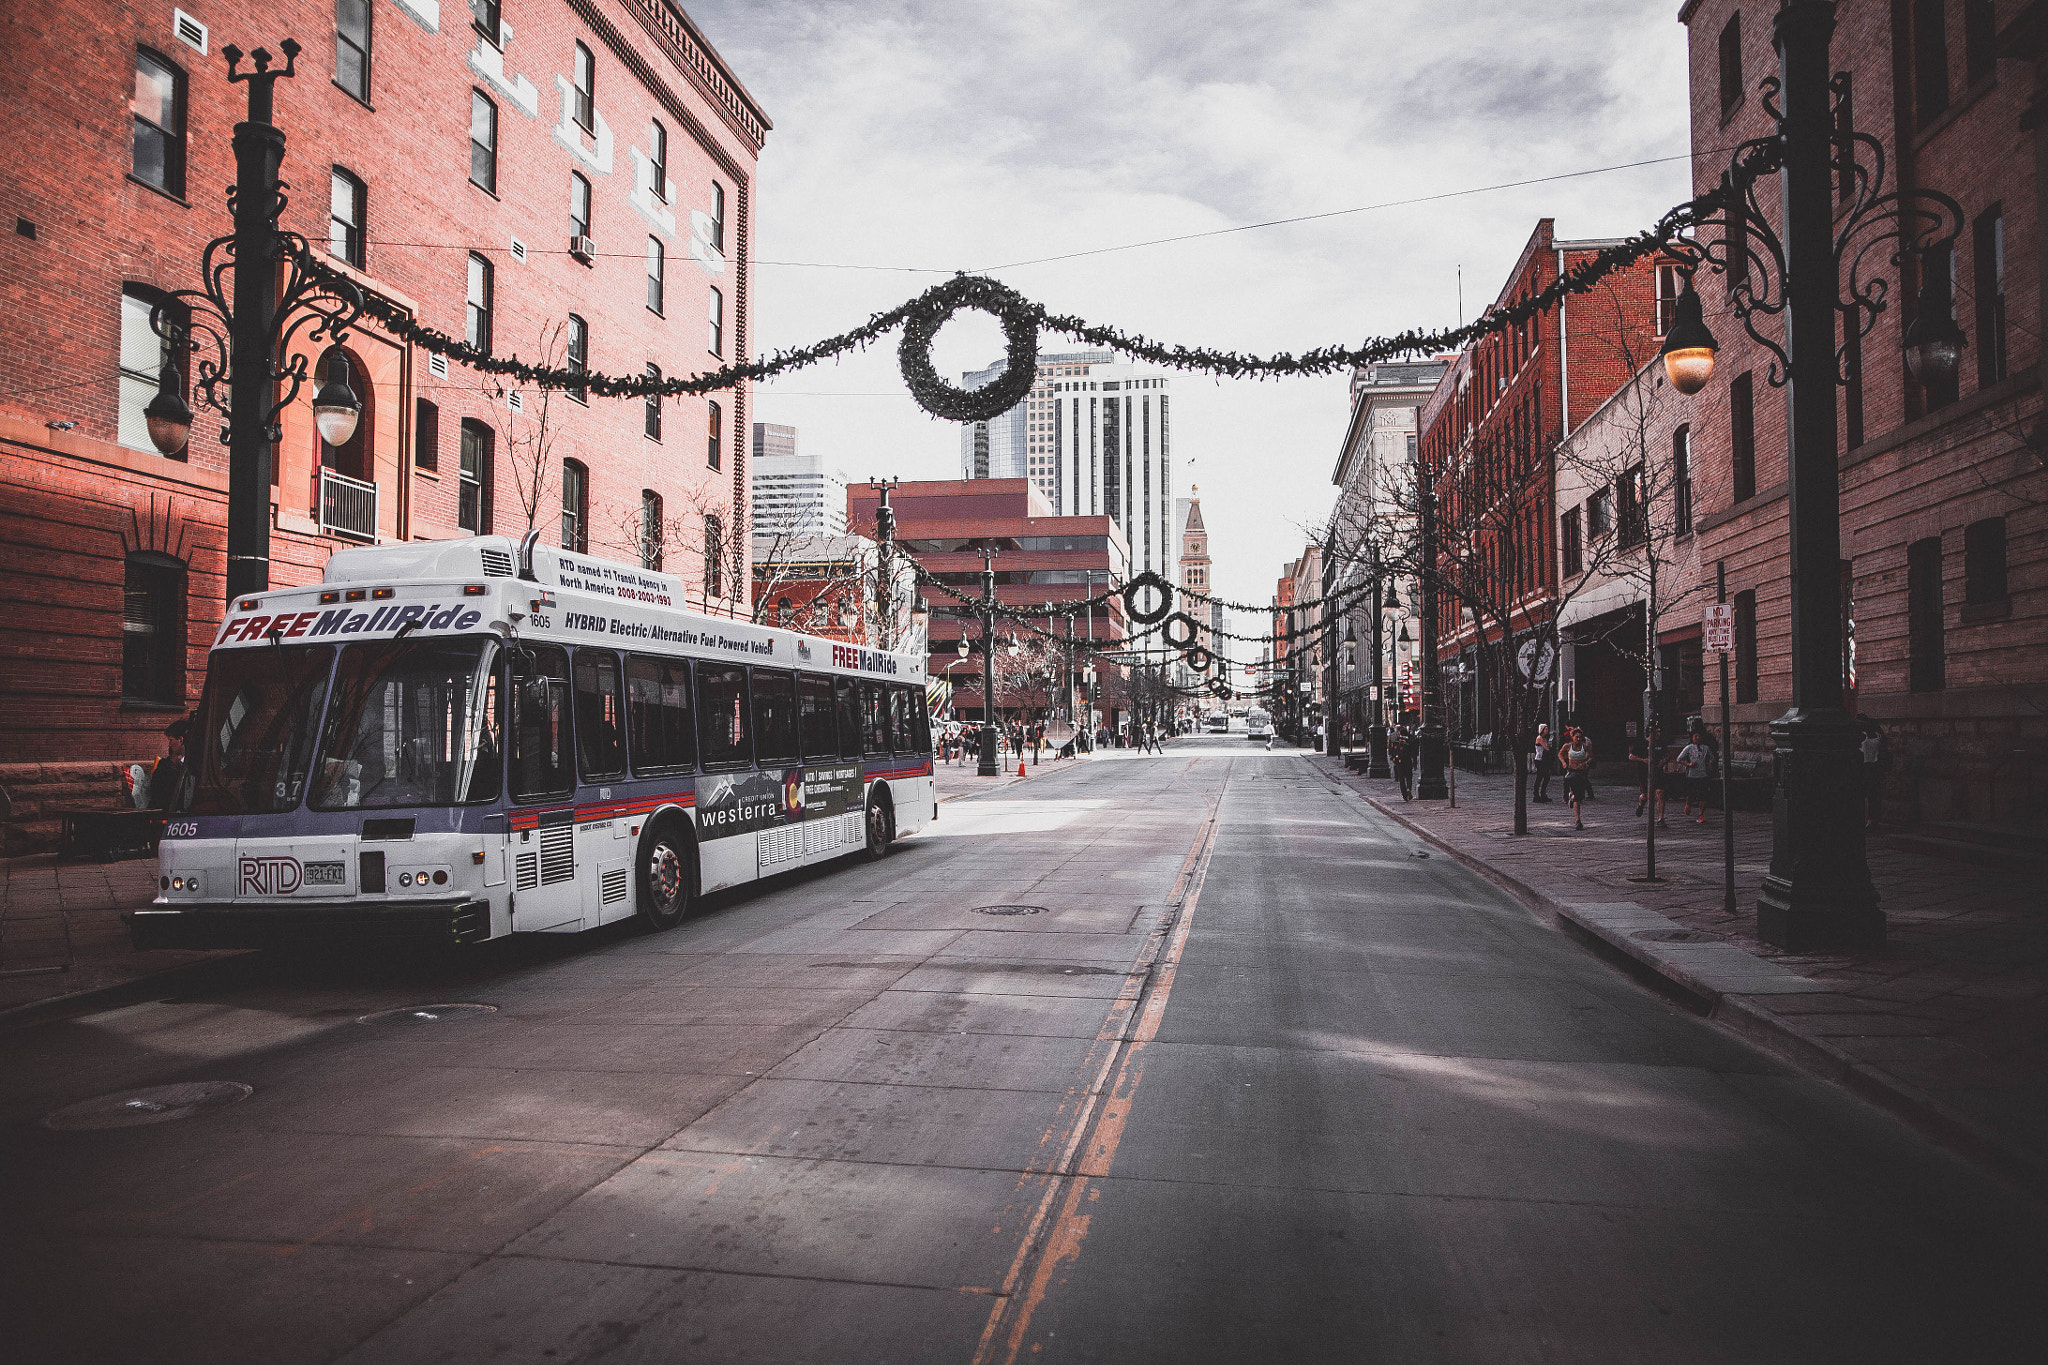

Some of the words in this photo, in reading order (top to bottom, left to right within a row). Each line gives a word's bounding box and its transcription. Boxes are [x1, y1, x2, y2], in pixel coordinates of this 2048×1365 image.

[559, 558, 575, 572] RTD
[577, 563, 601, 578] named
[603, 568, 612, 580] #1
[613, 571, 637, 586] Transit
[638, 577, 660, 593] Agency
[660, 581, 668, 592] in
[559, 575, 582, 589] North
[584, 580, 615, 596] America
[530, 613, 551, 628] 1605
[1713, 606, 1723, 617] NO
[1707, 618, 1731, 628] PARKING
[565, 612, 607, 633] HYBRID
[609, 619, 698, 645] Electric/Alternative
[700, 633, 716, 648] Fuel
[718, 636, 749, 653] Powered
[751, 641, 774, 656] Vehicle
[741, 795, 759, 803] CREDIT
[760, 793, 775, 801] UNION
[702, 799, 776, 827] westerra
[167, 823, 198, 837] 1605
[238, 855, 303, 895] RTD
